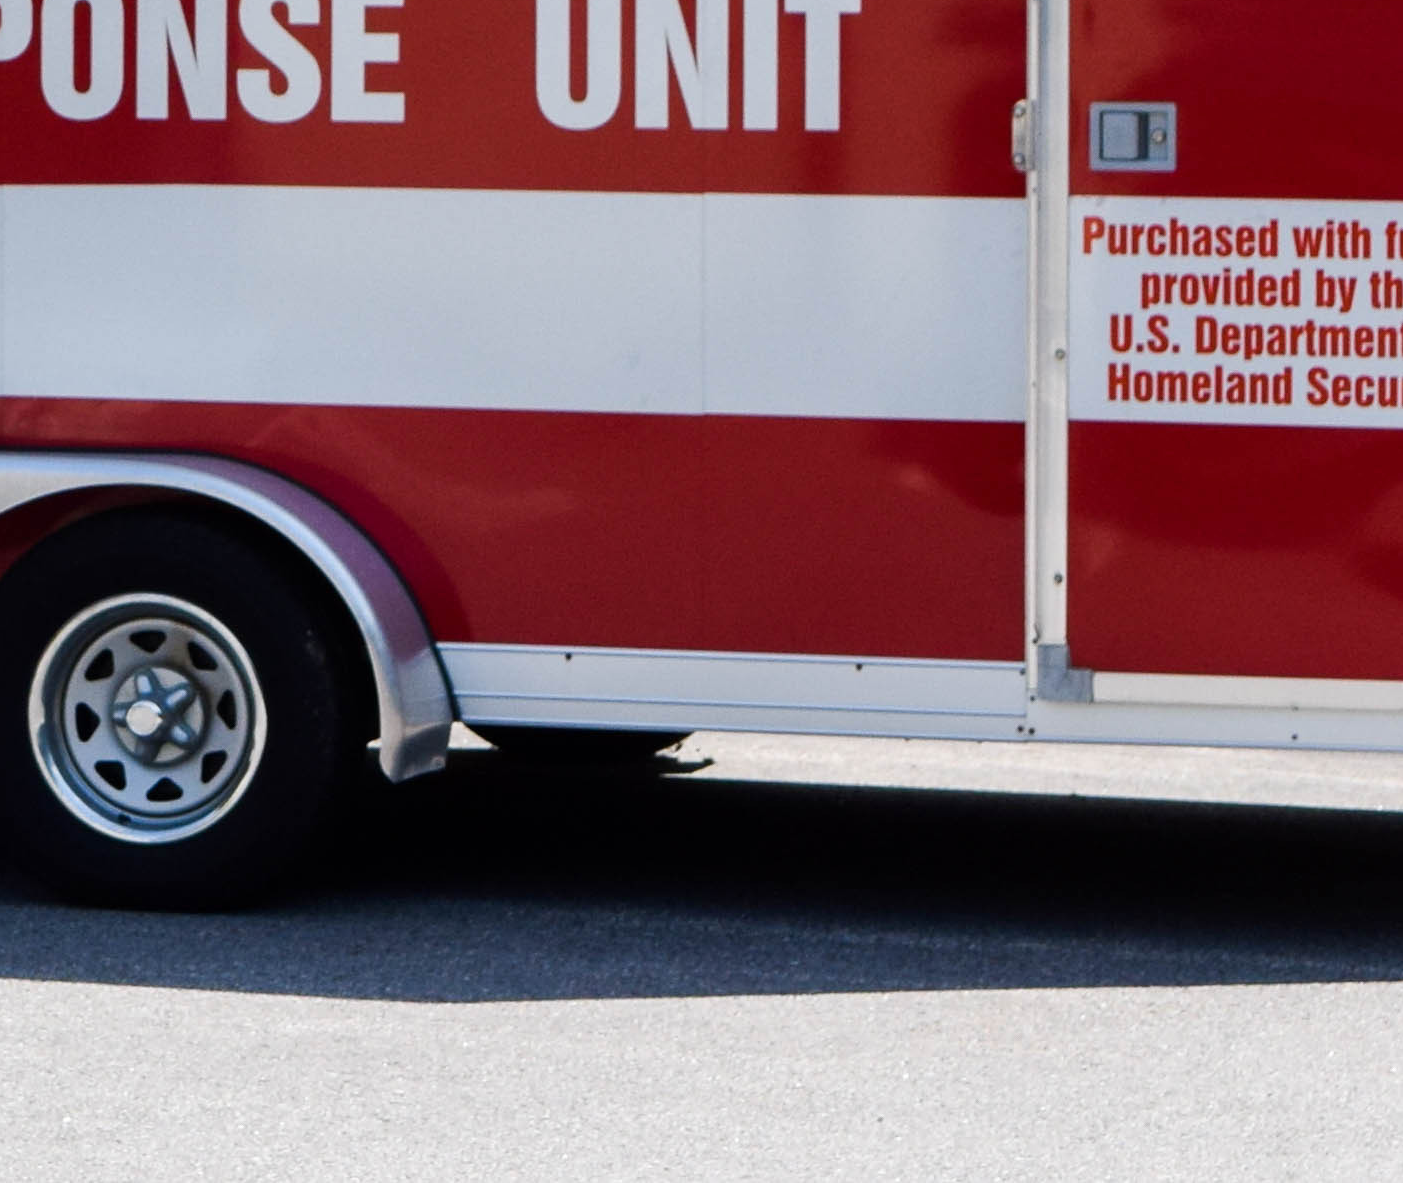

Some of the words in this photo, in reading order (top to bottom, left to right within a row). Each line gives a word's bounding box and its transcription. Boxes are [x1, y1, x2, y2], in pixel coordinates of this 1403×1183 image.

[1082, 216, 1279, 257] Purchased
[1293, 220, 1372, 259] with
[1140, 267, 1300, 309] provided
[1315, 269, 1358, 312] by
[1110, 314, 1181, 354] U.S.
[1107, 363, 1293, 405] Homeland
